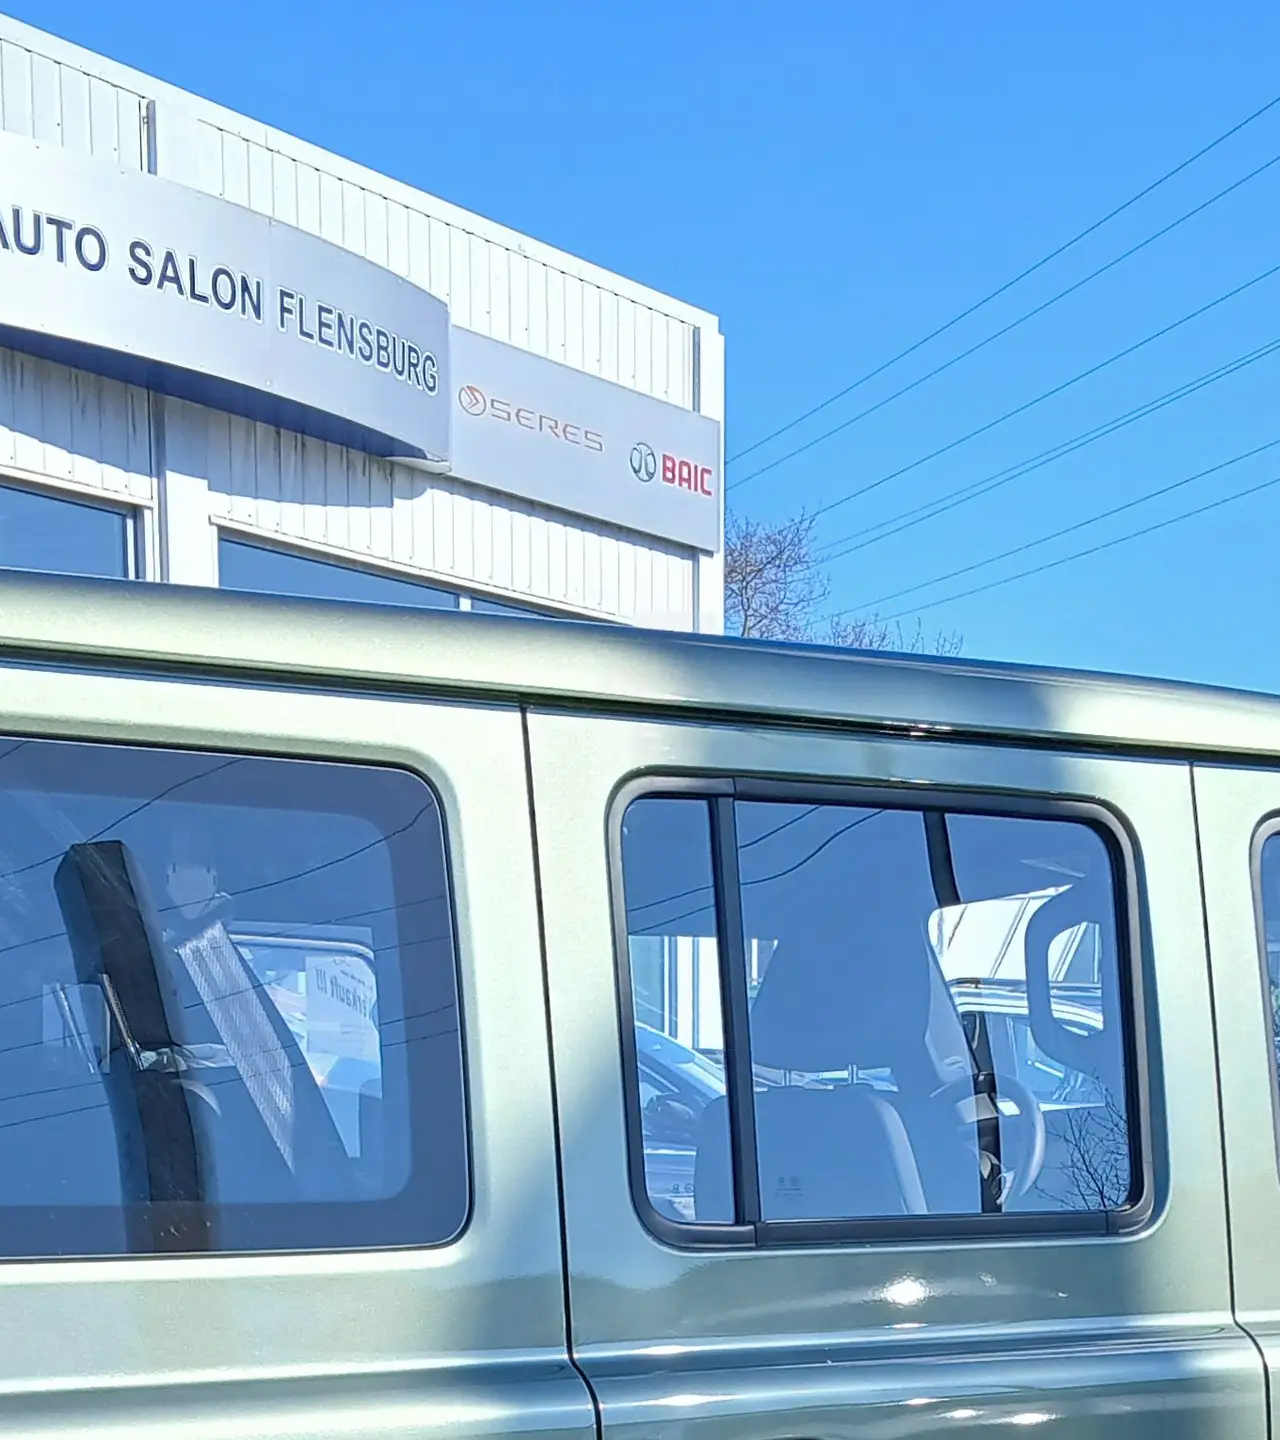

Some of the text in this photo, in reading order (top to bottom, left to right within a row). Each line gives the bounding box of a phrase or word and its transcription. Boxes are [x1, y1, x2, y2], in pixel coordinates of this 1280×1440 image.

[128, 240, 262, 321] SALON
[278, 288, 438, 393] FLENSBURG
[490, 398, 604, 452] SERES
[662, 453, 713, 496] BAIC
